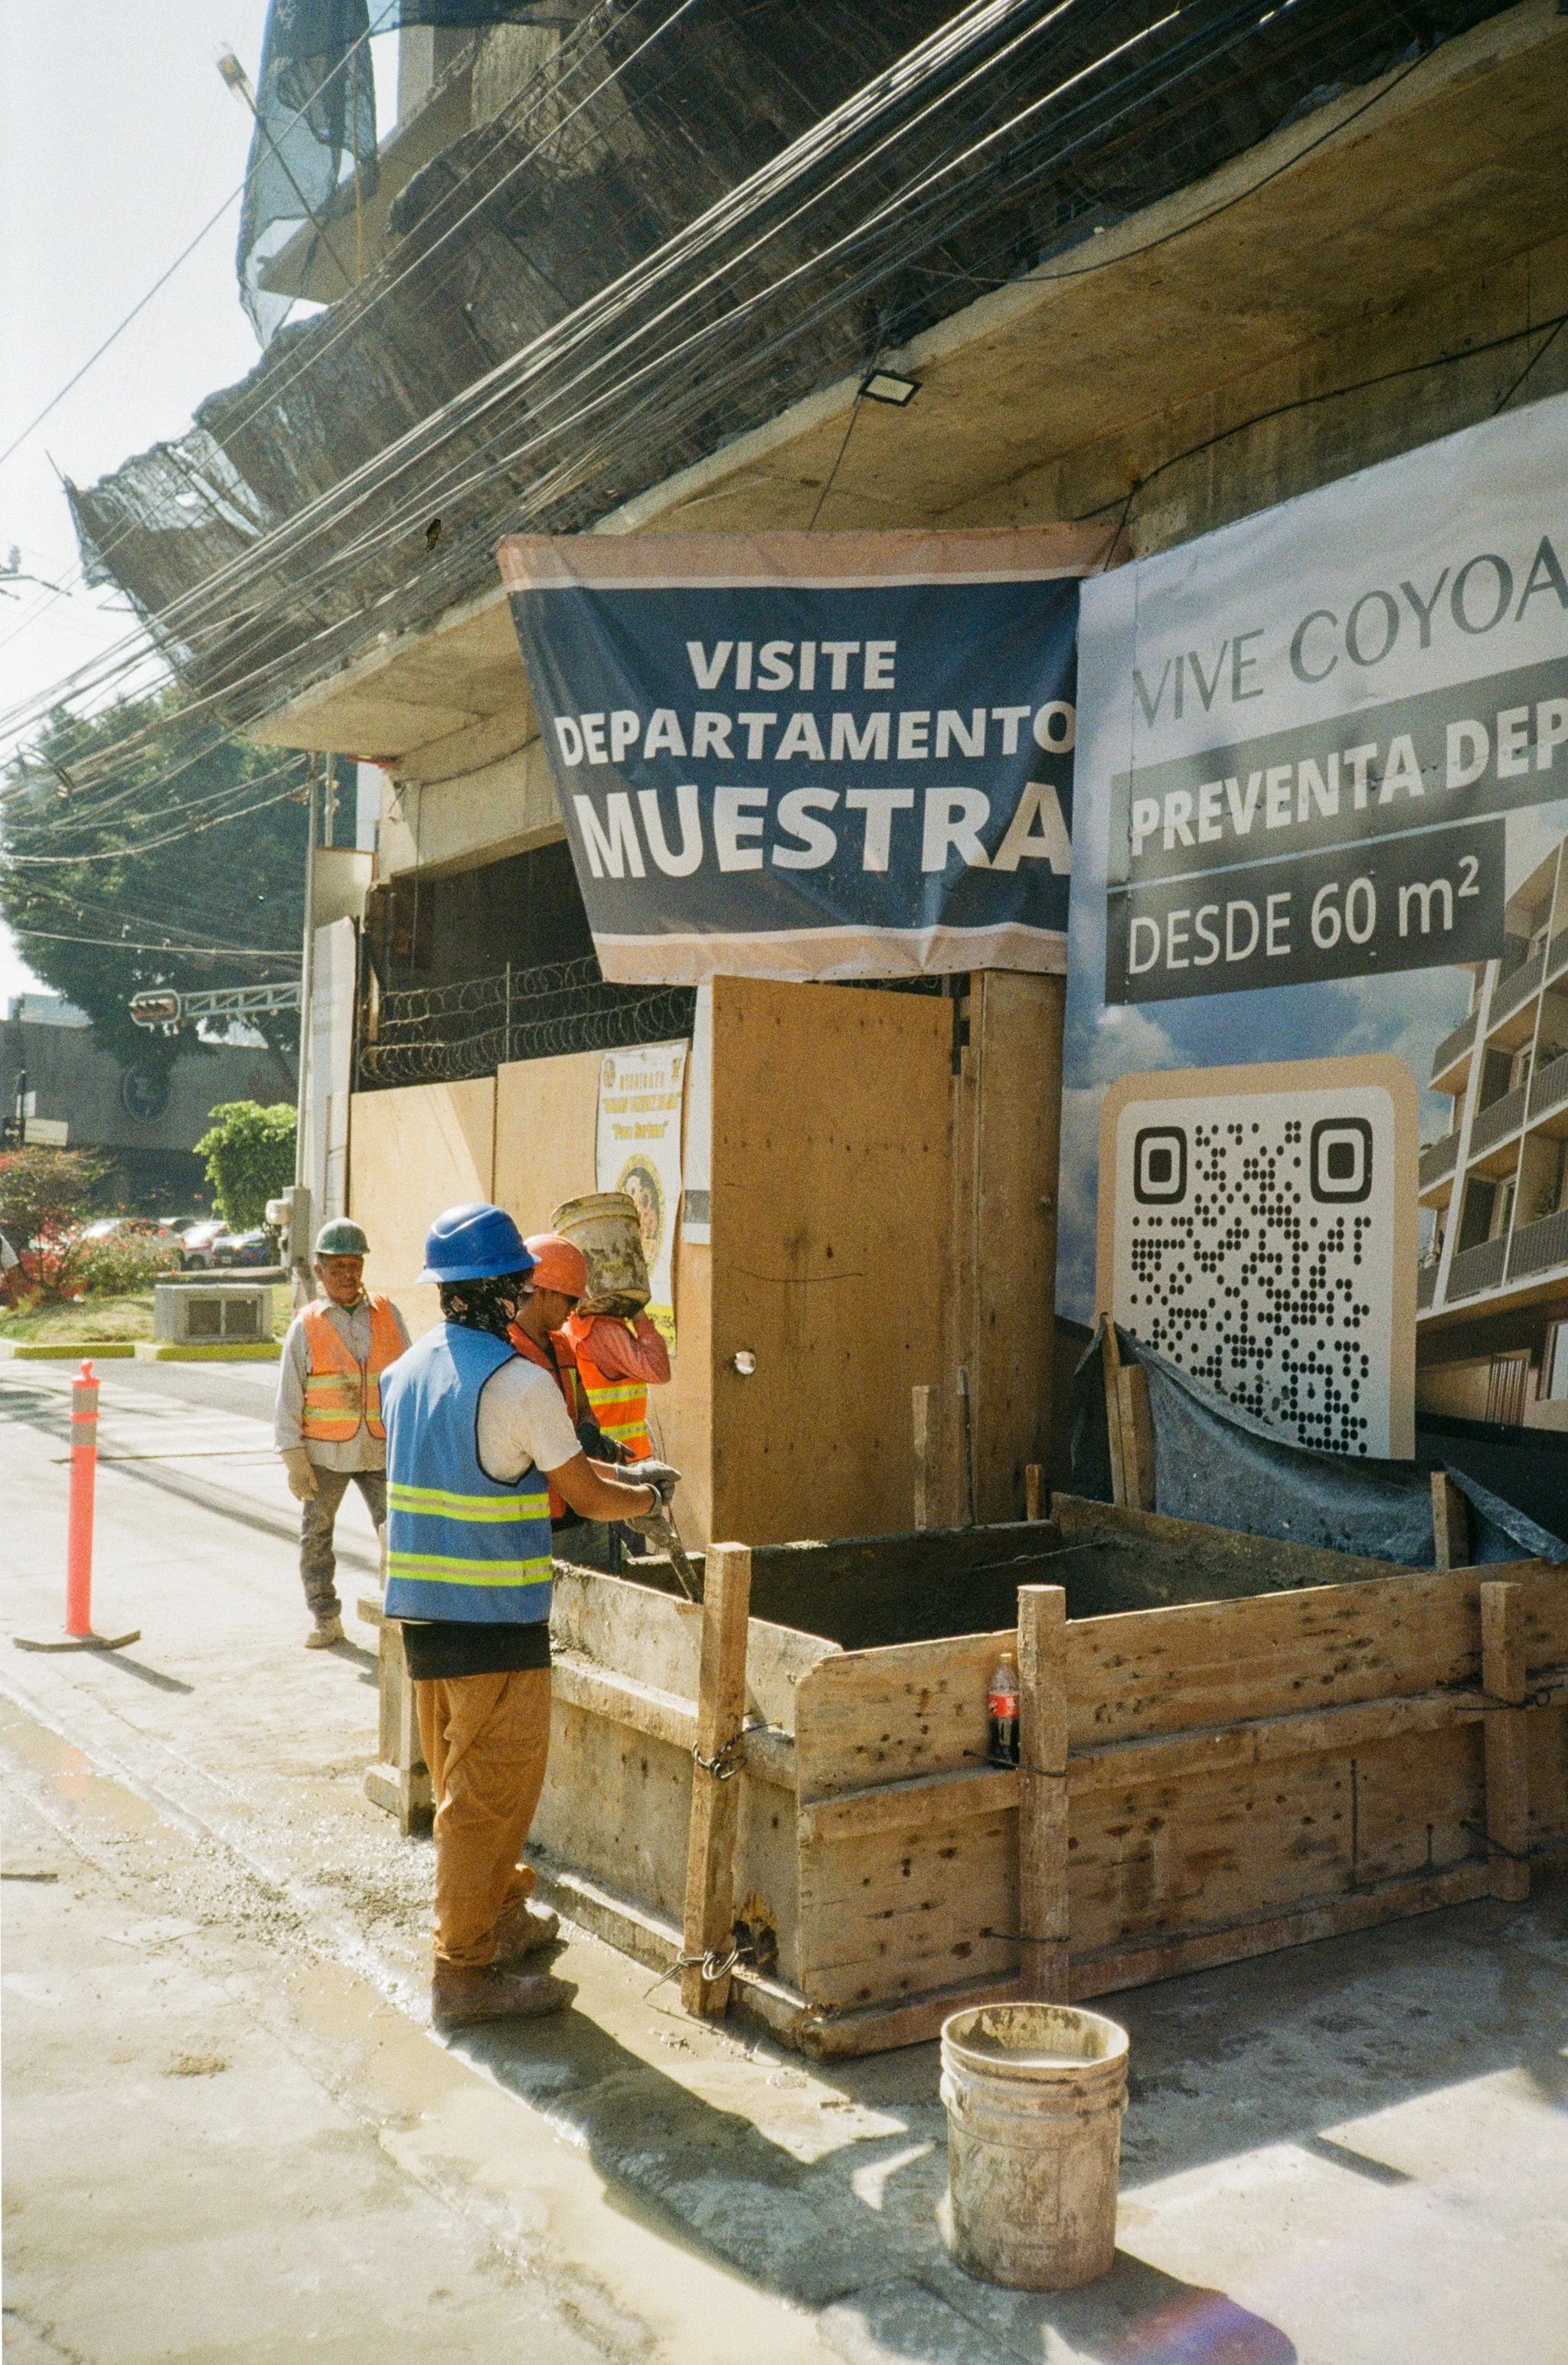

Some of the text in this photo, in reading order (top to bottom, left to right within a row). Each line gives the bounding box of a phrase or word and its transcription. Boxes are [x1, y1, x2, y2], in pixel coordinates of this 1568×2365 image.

[685, 640, 897, 690] VISITE
[1133, 534, 1568, 727] VIVE COYOA
[554, 701, 1076, 766] DEPARTAMENTO
[1131, 697, 1568, 857] PREVENTA DEP
[573, 781, 1073, 878] MUESTRA
[1129, 893, 1292, 975] DESDE
[1311, 877, 1377, 949] 60
